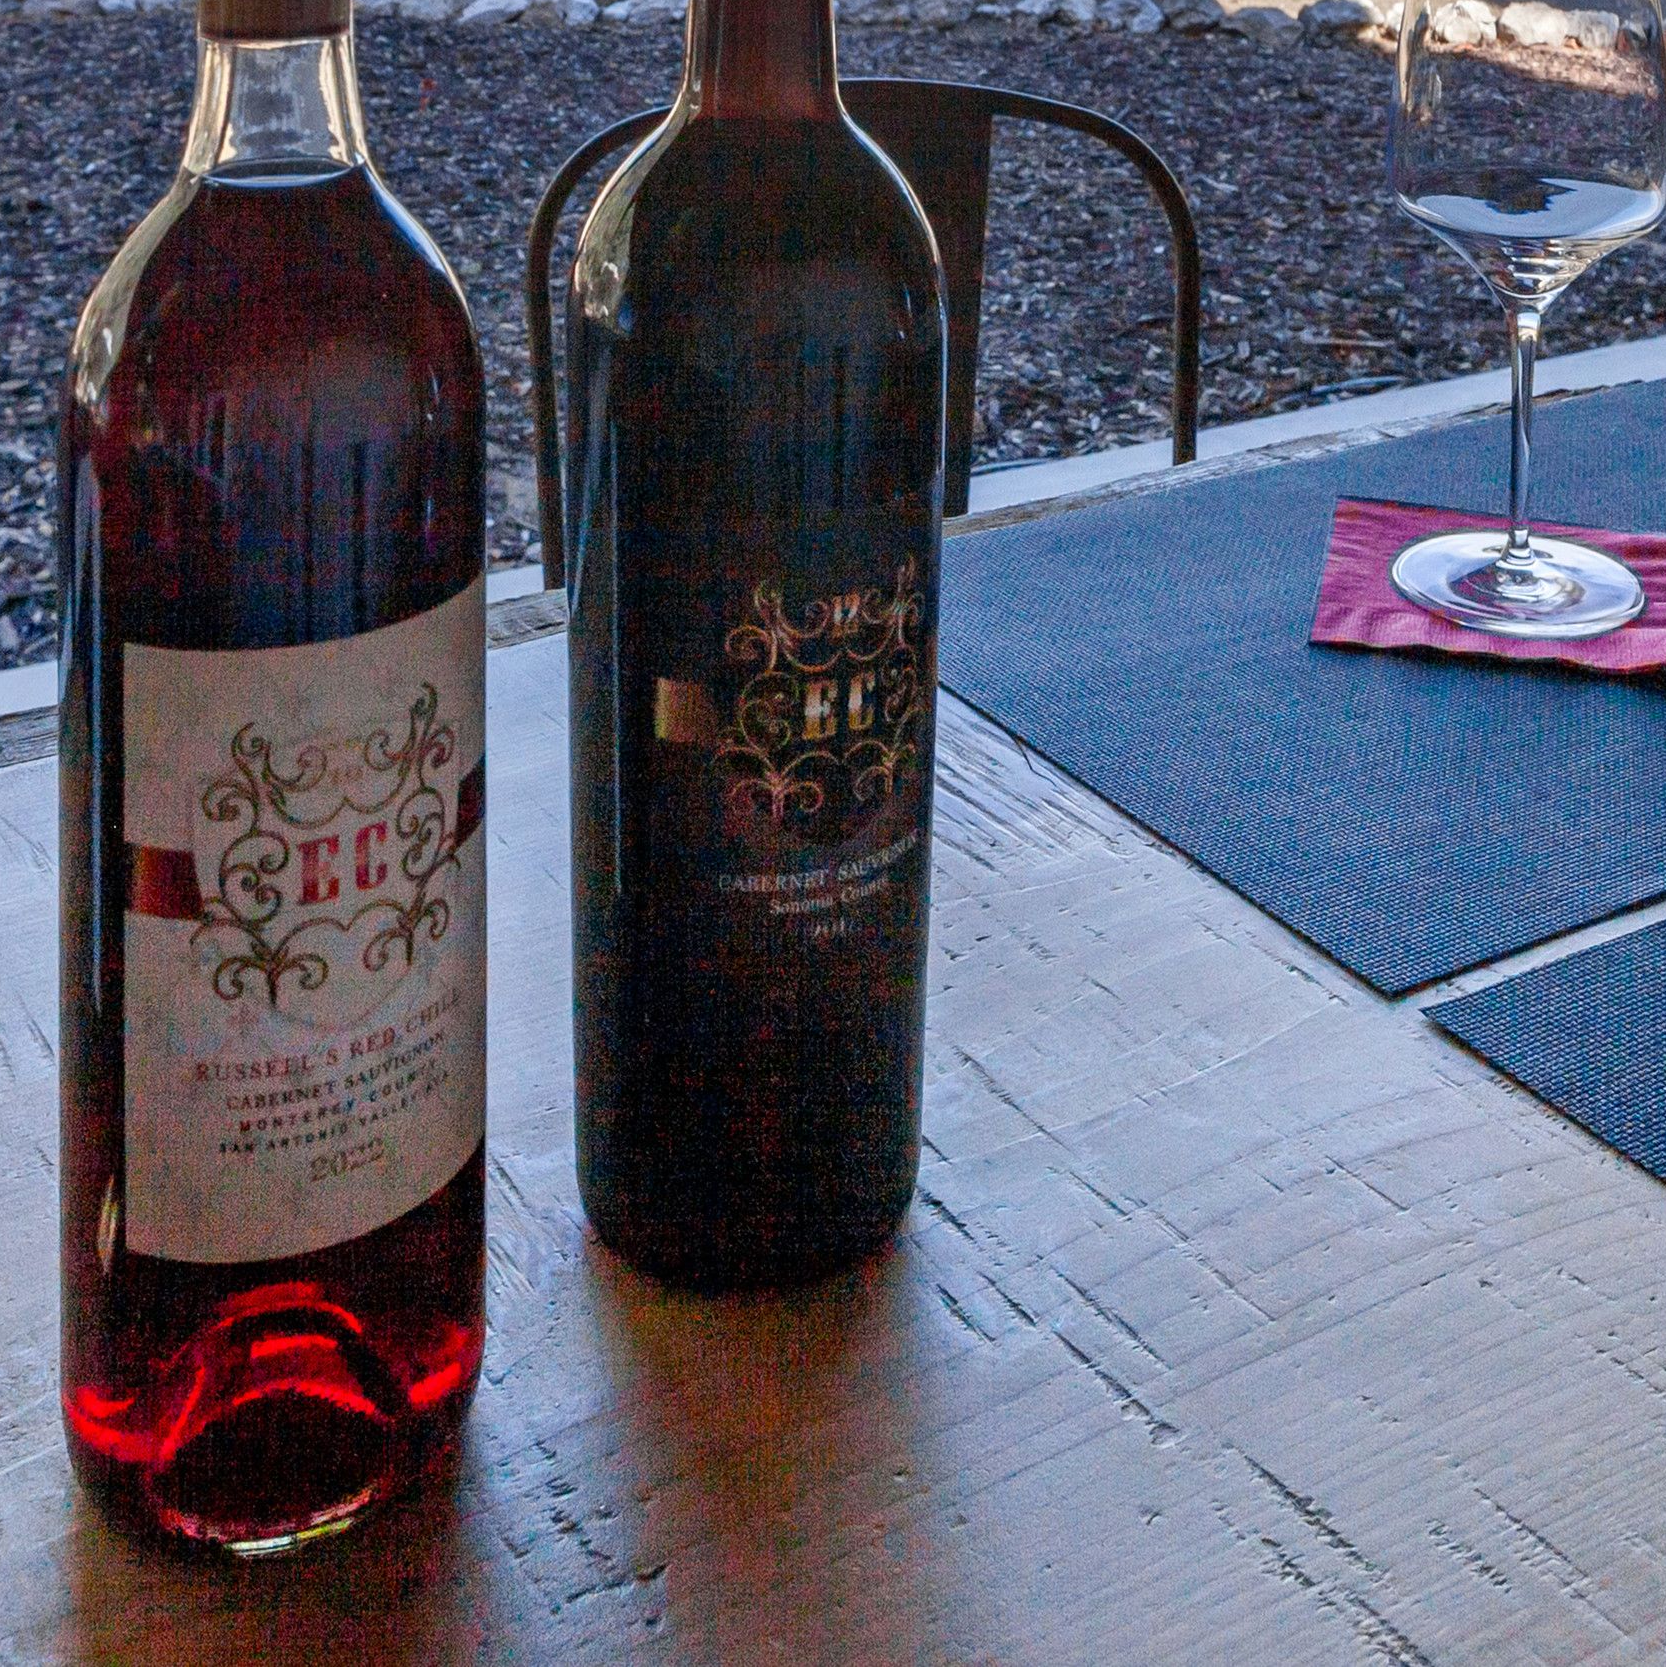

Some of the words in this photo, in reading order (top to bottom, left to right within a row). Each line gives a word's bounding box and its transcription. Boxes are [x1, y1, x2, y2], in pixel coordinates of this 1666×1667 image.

[296, 821, 387, 905] EC
[718, 869, 829, 892] CABERNET
[225, 1080, 337, 1111] CABERNET
[344, 1030, 445, 1090] SAUVIGNON
[349, 1027, 397, 1060] RED
[238, 1098, 356, 1134] MONTEREY
[369, 1058, 437, 1103] COUNTY
[219, 1141, 255, 1156] SAN
[265, 1122, 349, 1151] ANTONIO
